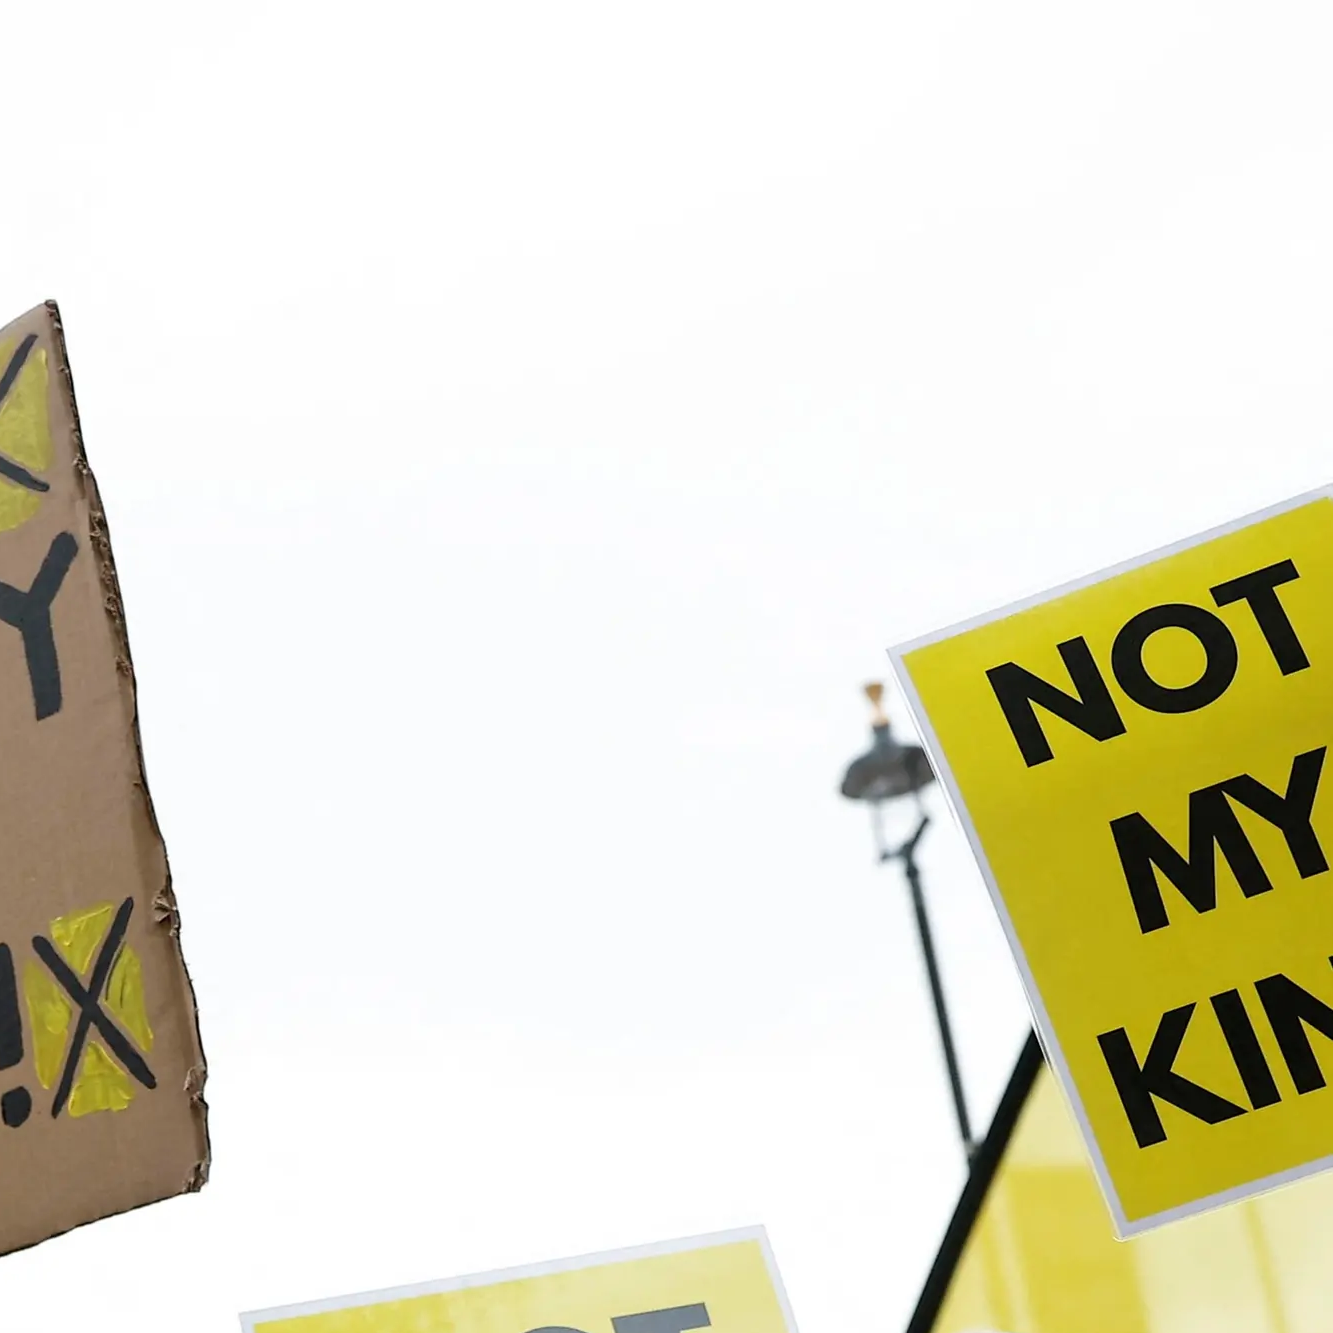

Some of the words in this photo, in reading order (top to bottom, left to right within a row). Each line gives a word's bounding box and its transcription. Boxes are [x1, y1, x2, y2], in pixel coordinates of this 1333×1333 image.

[985, 558, 1311, 768] NOT
[1109, 746, 1331, 935] MY
[1096, 955, 1333, 1150] KIN
